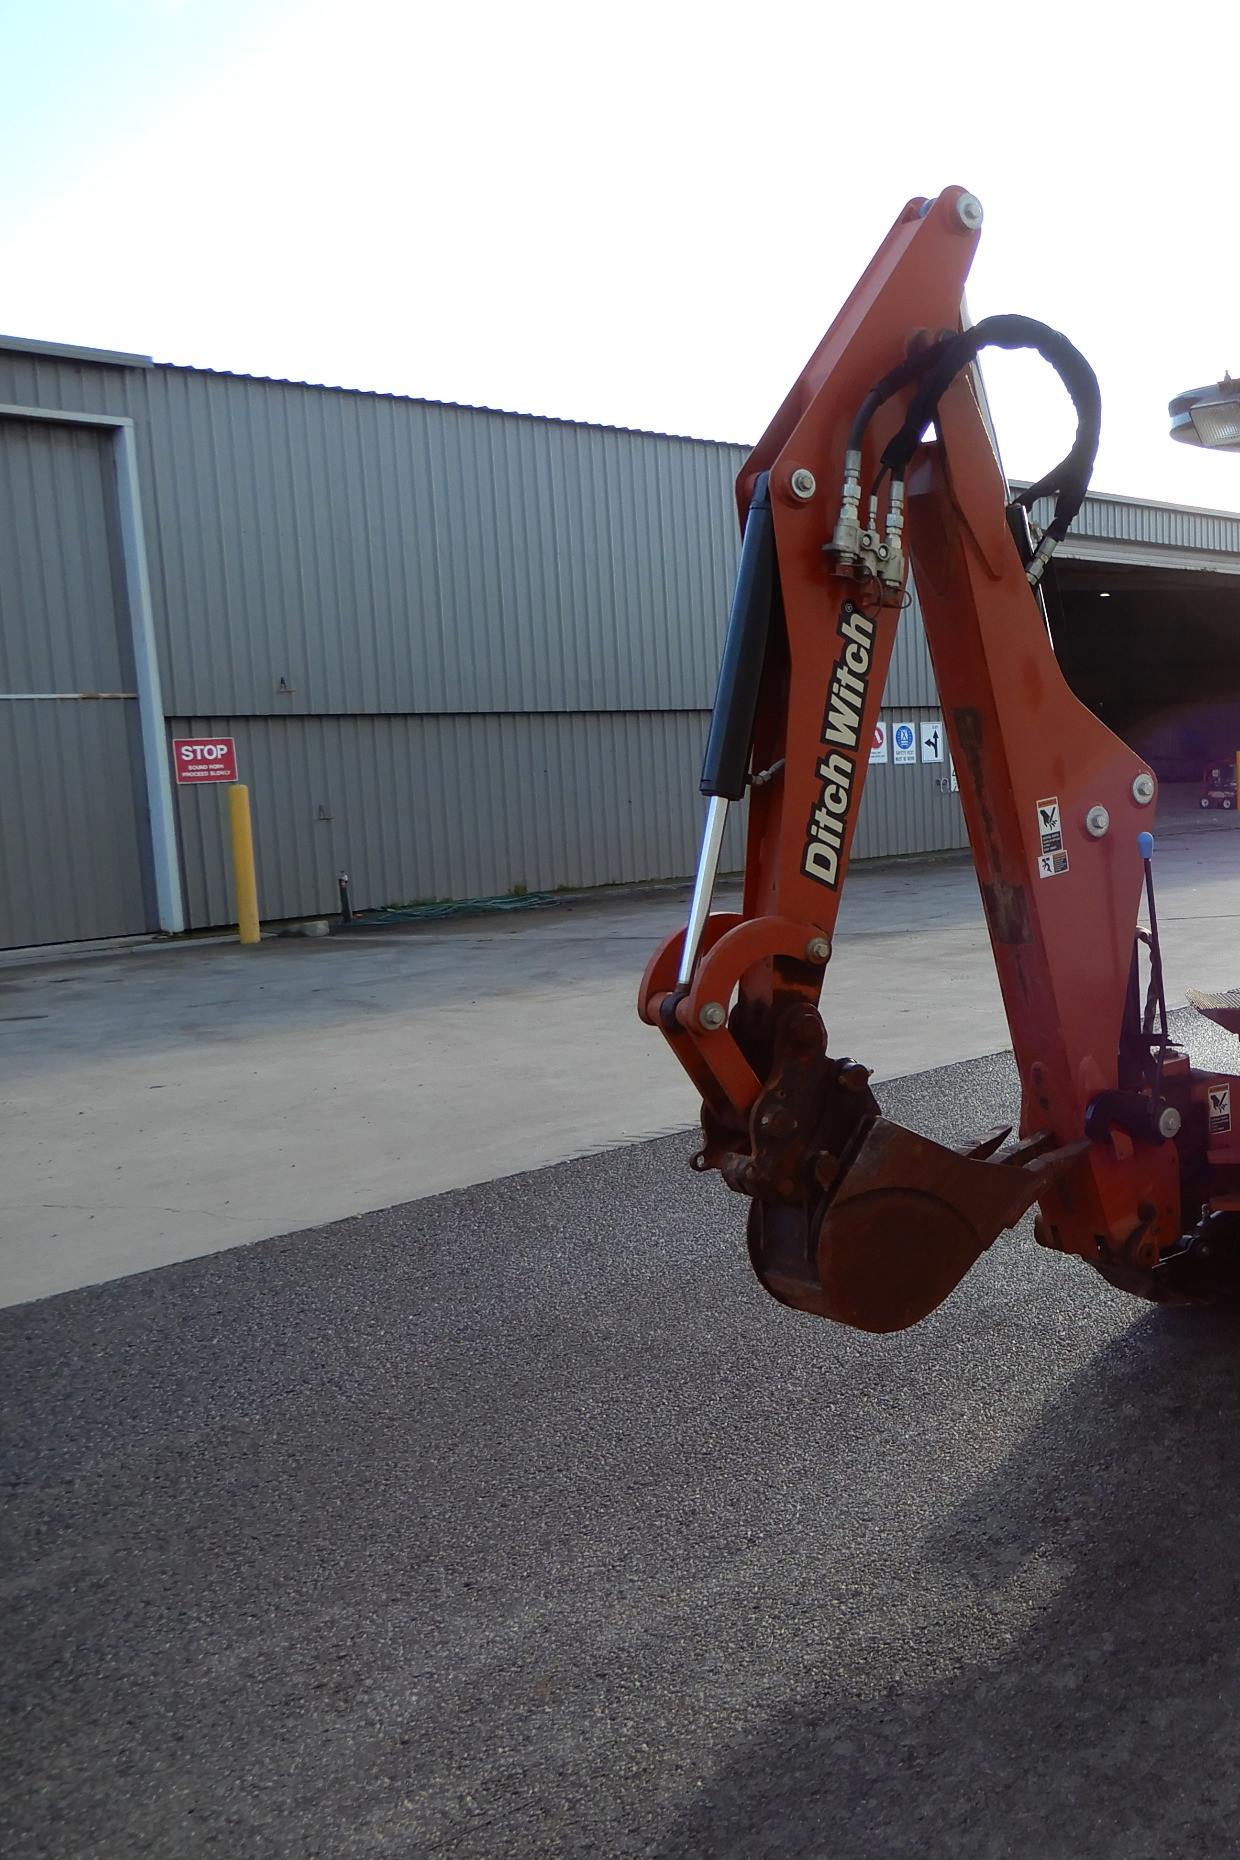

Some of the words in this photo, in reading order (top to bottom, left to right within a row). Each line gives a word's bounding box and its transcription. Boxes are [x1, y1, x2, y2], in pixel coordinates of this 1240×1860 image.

[825, 612, 874, 747] Witch
[181, 744, 228, 761] STOP
[805, 753, 853, 885] Ditch
